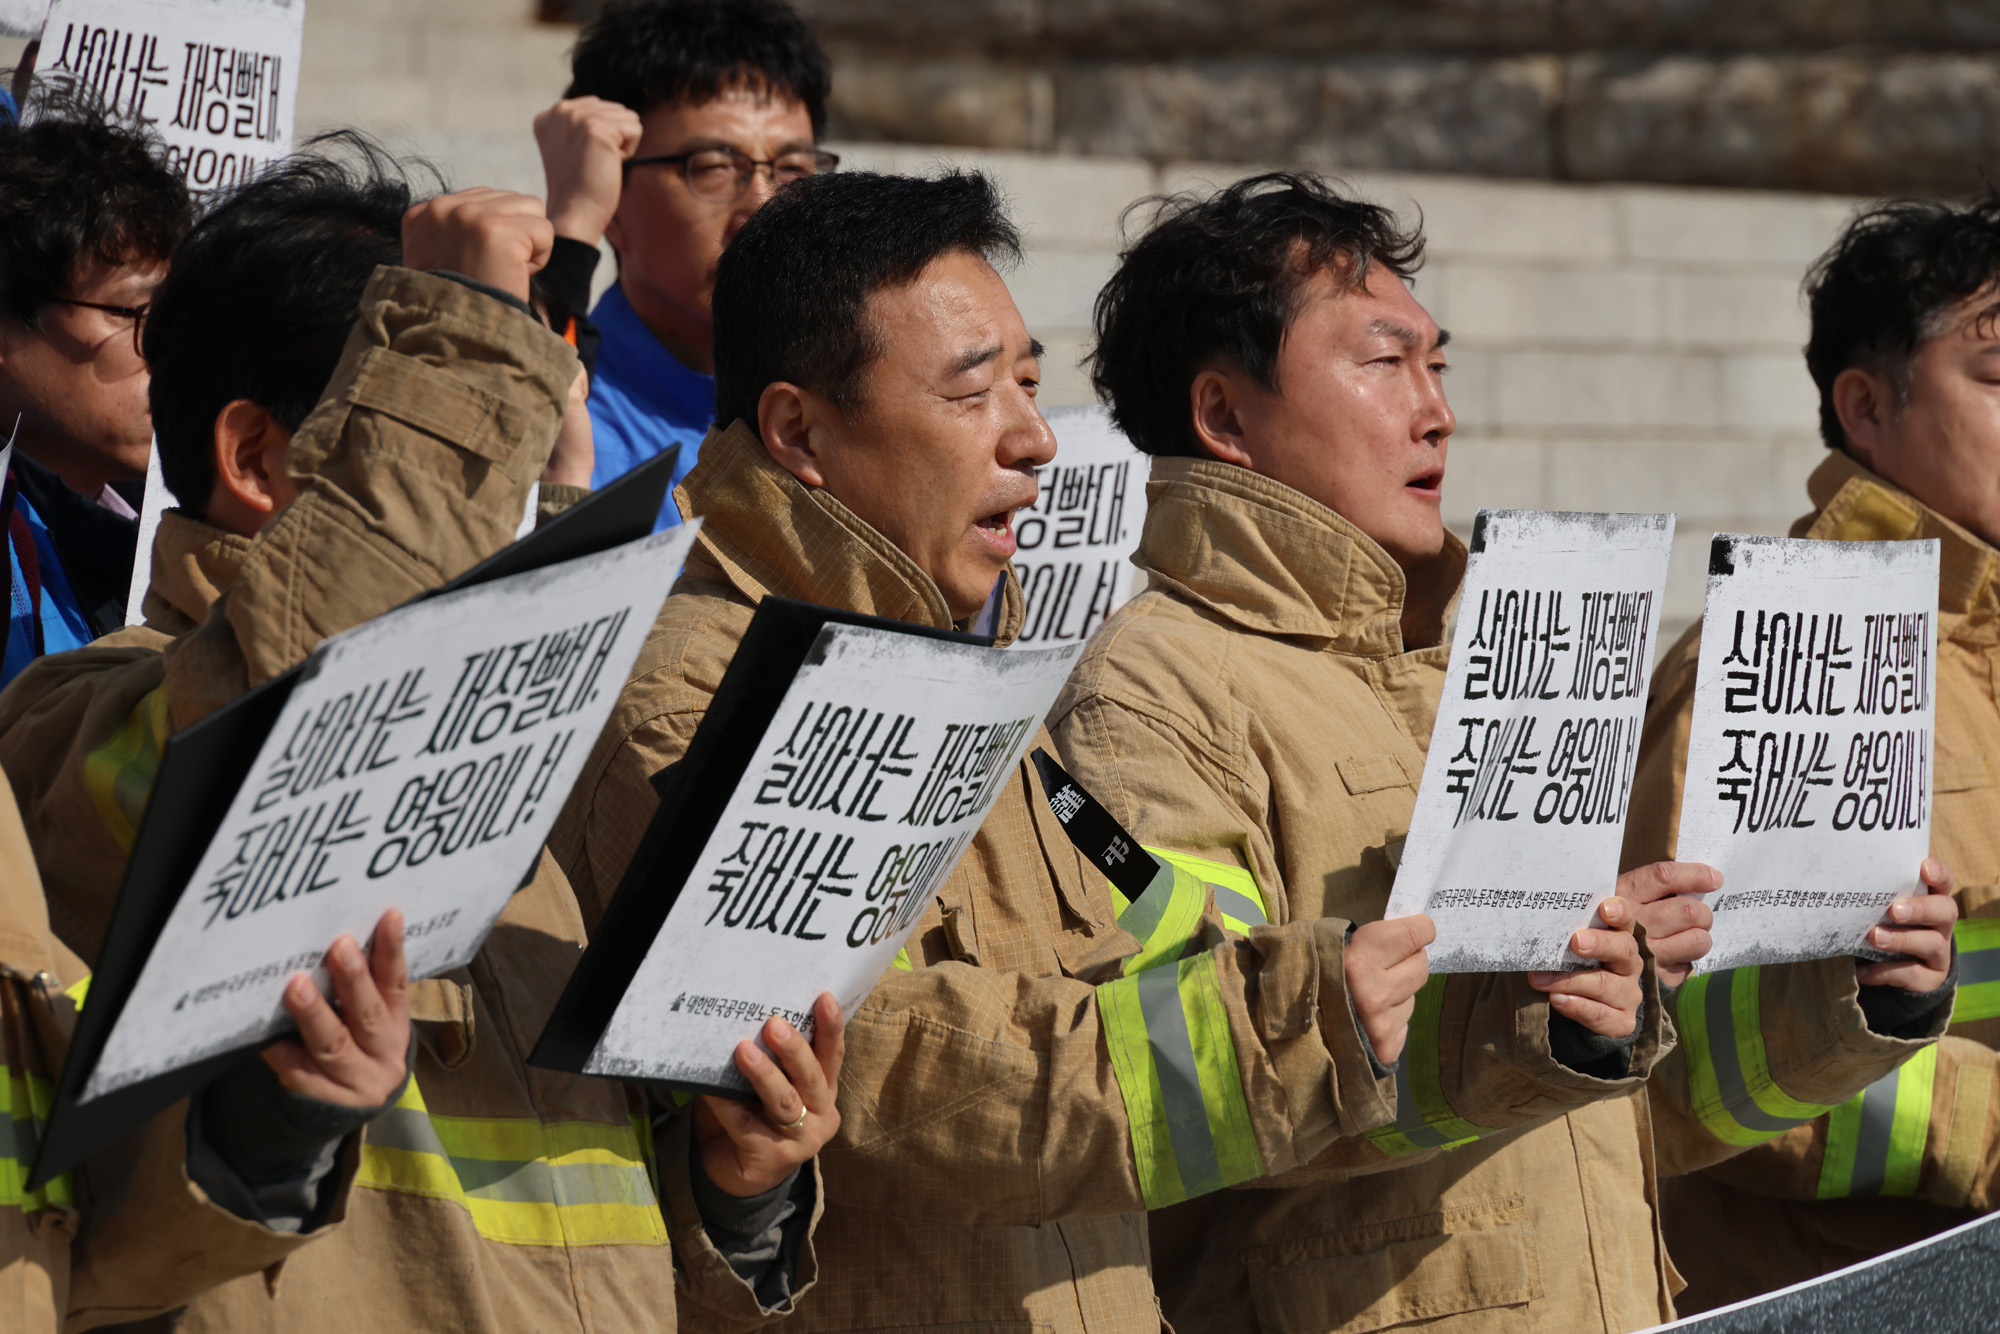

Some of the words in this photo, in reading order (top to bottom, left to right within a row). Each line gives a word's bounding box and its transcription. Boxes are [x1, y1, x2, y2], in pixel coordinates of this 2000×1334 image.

[1463, 588, 1571, 700] 살아서는
[1722, 610, 1852, 716] 살아서는
[250, 667, 431, 815] 살아서는
[754, 701, 919, 822] 살아서는
[1446, 716, 1541, 828] 죽어서는
[1716, 729, 1836, 834] 죽어서는
[202, 789, 371, 932] 죽어서는
[704, 821, 859, 940] 죽어서는
[1427, 888, 1527, 909] 한민국공무원노동조합총연맹
